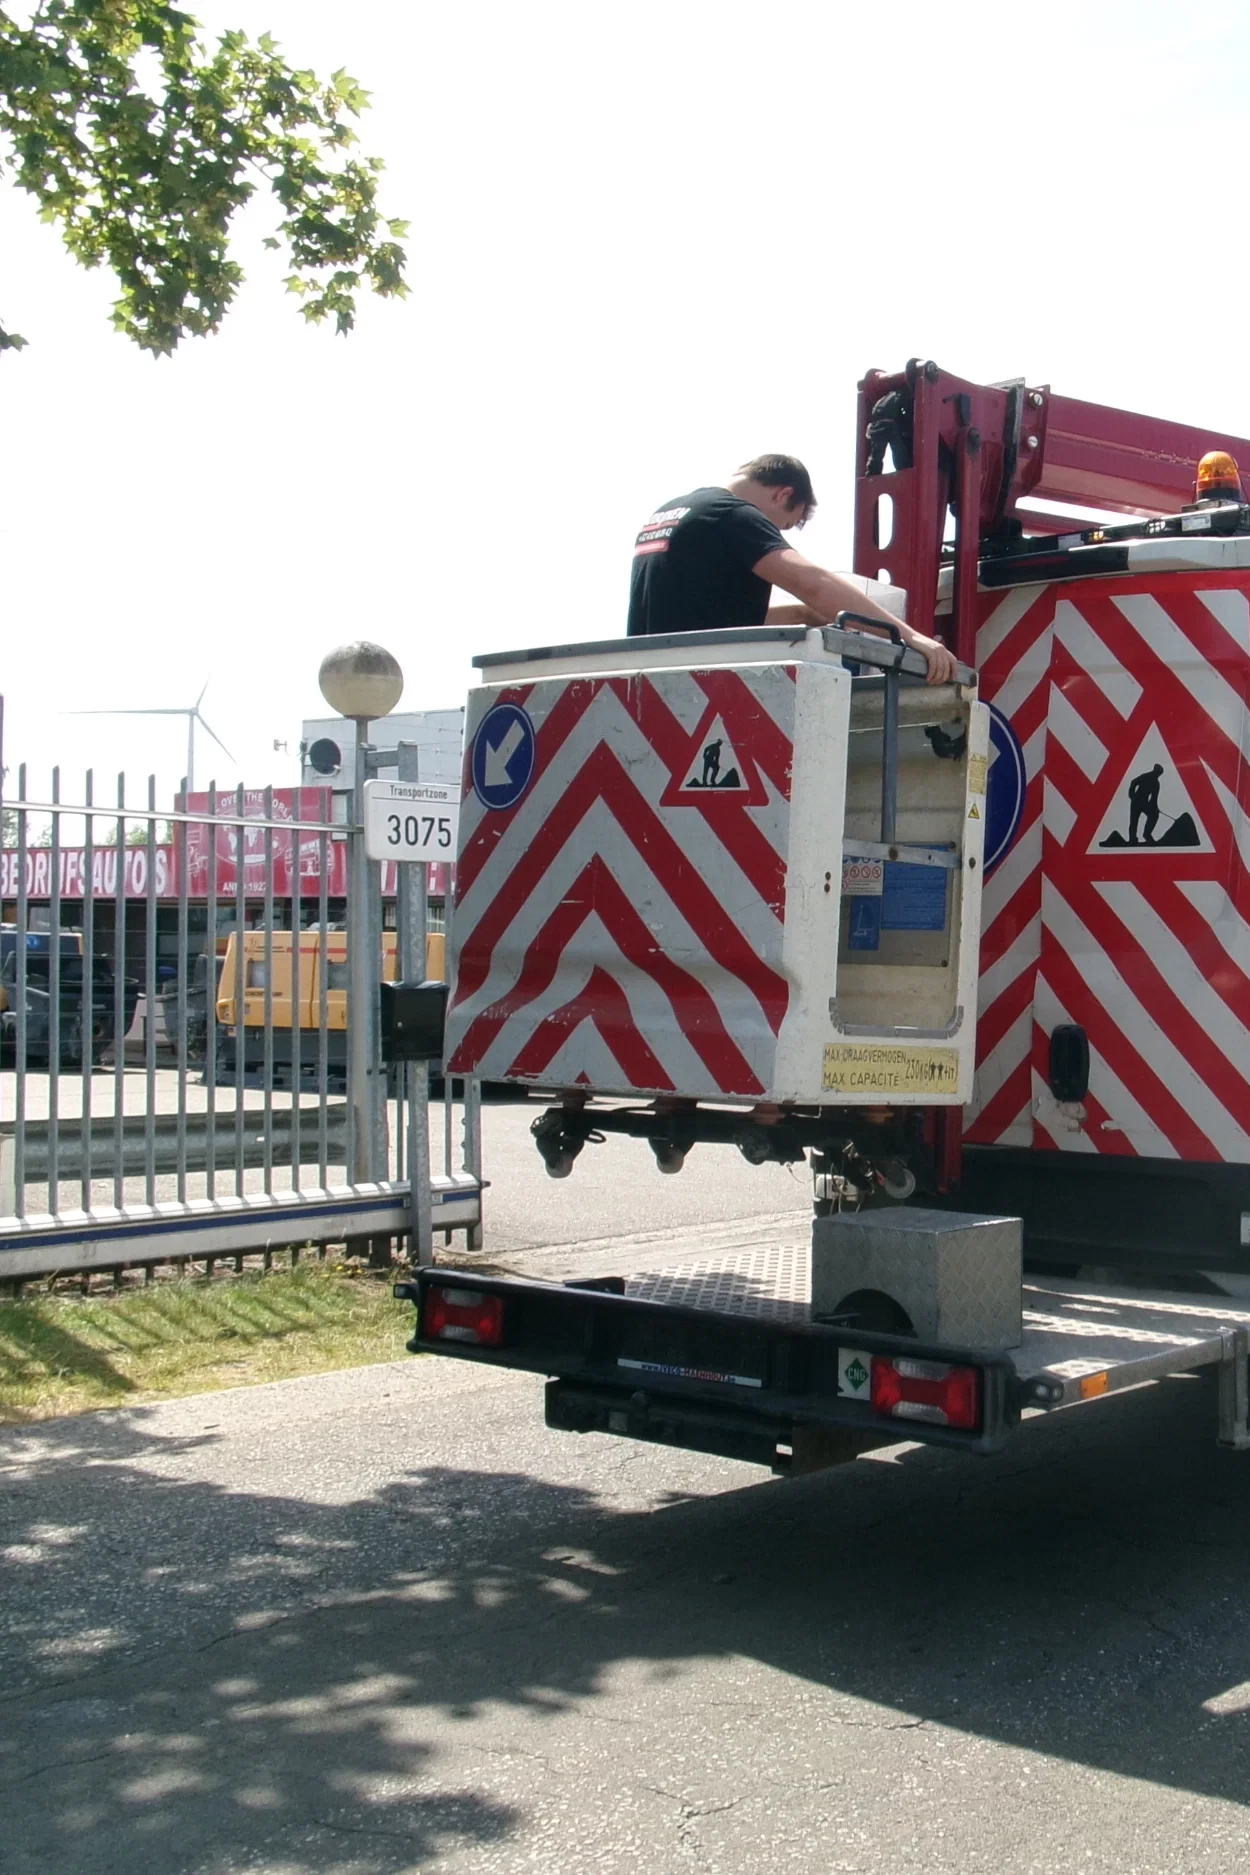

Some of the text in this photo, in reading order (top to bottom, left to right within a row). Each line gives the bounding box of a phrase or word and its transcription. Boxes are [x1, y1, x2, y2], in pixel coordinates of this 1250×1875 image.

[246, 792, 263, 802] THE
[390, 785, 448, 799] Transportzone
[388, 814, 451, 847] 3075
[823, 1071, 900, 1086] MAX CAPACITÉ
[848, 1367, 866, 1381] CNG
